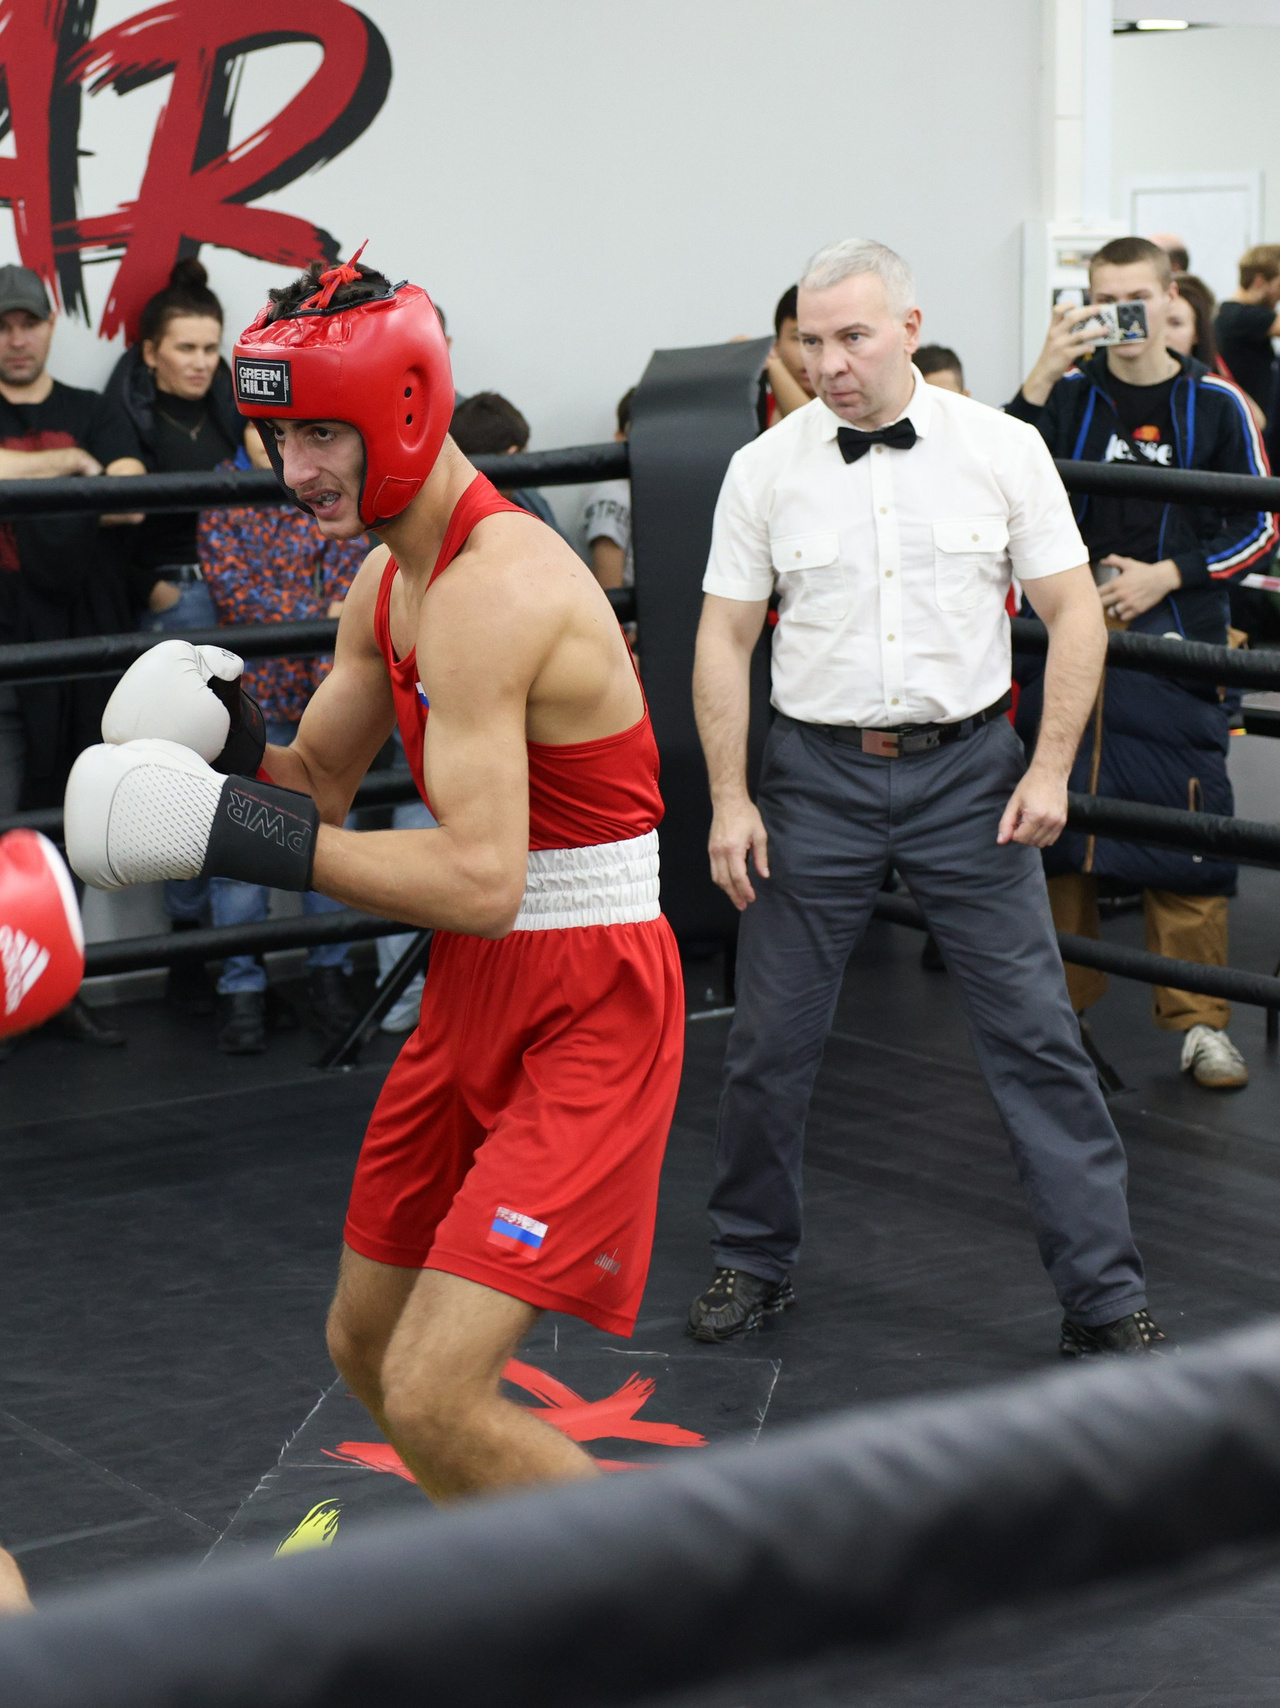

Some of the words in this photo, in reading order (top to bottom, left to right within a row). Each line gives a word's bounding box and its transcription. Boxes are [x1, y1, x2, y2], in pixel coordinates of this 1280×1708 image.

[239, 366, 281, 381] GREEN
[240, 379, 275, 396] HILL
[226, 790, 313, 857] PWR
